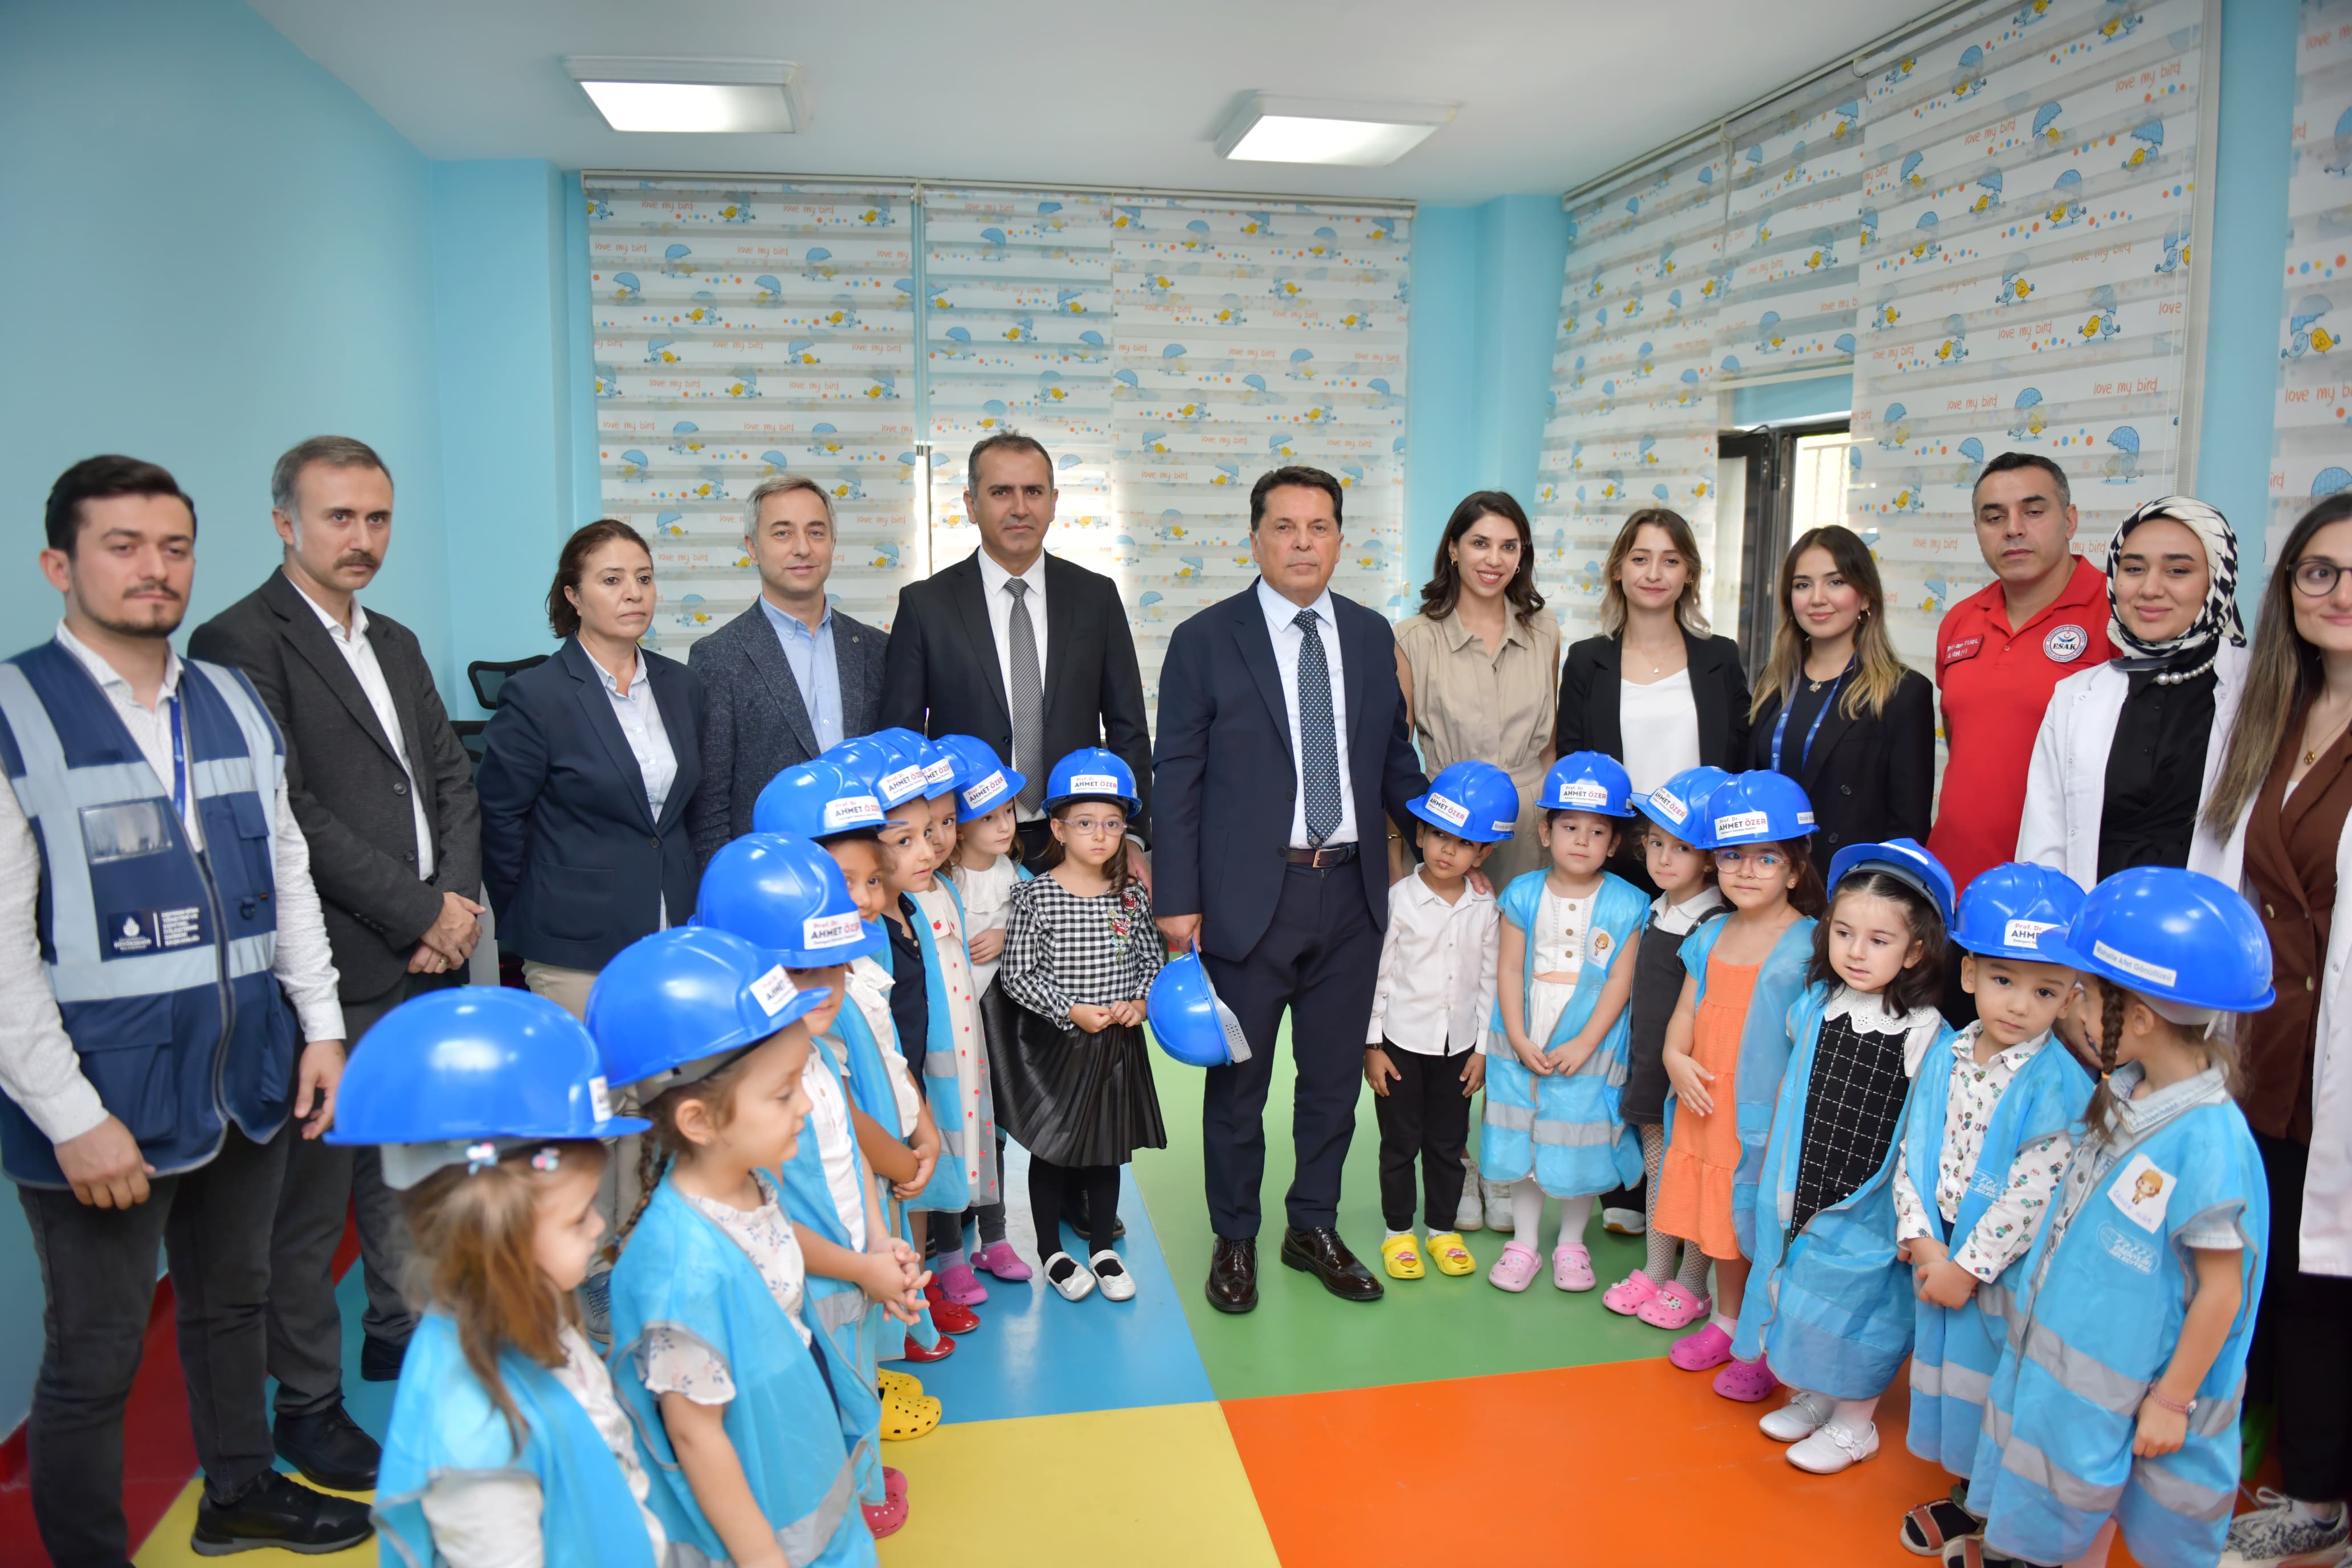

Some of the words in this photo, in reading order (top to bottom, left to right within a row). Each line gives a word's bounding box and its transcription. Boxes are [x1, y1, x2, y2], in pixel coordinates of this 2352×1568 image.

[2114, 76, 2135, 92] love
[2141, 72, 2155, 88] my
[2160, 58, 2180, 78] bird
[1964, 132, 1981, 145] love
[1984, 128, 1996, 142] my
[1999, 119, 2016, 133] bird
[1864, 173, 1873, 185] my
[1875, 164, 1888, 177] bird
[640, 199, 658, 209] love
[662, 202, 675, 212] my
[678, 200, 693, 211] bird
[783, 203, 799, 212] love
[803, 205, 816, 215] my
[819, 203, 835, 214] bird
[594, 241, 611, 251] love
[616, 244, 628, 255] my
[631, 244, 647, 252] bird
[757, 247, 770, 258] my
[773, 246, 789, 255] bird
[2071, 251, 2089, 263] love
[2094, 248, 2108, 263] my
[2112, 241, 2131, 255] bird
[897, 251, 909, 261] my
[1163, 305, 1174, 315] my
[1177, 304, 1191, 314] bird
[1820, 300, 1835, 312] love
[1838, 300, 1849, 309] my
[2158, 301, 2182, 315] love
[1272, 309, 1287, 317] love
[1291, 311, 1301, 320] my
[1304, 309, 1319, 319] bird
[1997, 328, 2015, 340] love
[2020, 326, 2032, 341] my
[2035, 320, 2052, 334] bird
[606, 337, 623, 347] bird
[712, 338, 728, 348] love
[733, 340, 745, 352] my
[748, 339, 764, 349] bird
[851, 340, 867, 350] love
[872, 343, 884, 354] my
[887, 343, 902, 353] bird
[1119, 344, 1130, 354] my
[1132, 343, 1148, 353] bird
[1228, 347, 1243, 356] love
[1247, 349, 1258, 359] my
[1261, 348, 1275, 358] bird
[1872, 350, 1885, 360] love
[1889, 349, 1897, 362] my
[1901, 345, 1914, 356] bird
[1372, 354, 1383, 364] my
[1385, 353, 1400, 362] bird
[649, 378, 665, 387] love
[669, 379, 682, 390] my
[685, 379, 701, 387] bird
[787, 381, 805, 389] love
[809, 382, 821, 392] my
[824, 382, 839, 391] bird
[2093, 382, 2112, 395] love
[2118, 383, 2132, 397] my
[2137, 376, 2158, 393] bird
[2284, 387, 2309, 403] love
[2317, 388, 2335, 406] my
[1946, 399, 1962, 410] love
[1966, 399, 1978, 412] my
[1981, 395, 1998, 407] bird
[602, 419, 620, 428] love
[623, 422, 636, 431] my
[639, 420, 655, 430] bird
[763, 423, 776, 432] my
[778, 422, 794, 431] bird
[881, 423, 897, 432] love
[901, 425, 912, 435] my
[1219, 436, 1230, 446] my
[1233, 436, 1248, 445] bird
[1344, 440, 1355, 449] my
[1357, 439, 1371, 448] bird
[1140, 469, 1157, 478] love
[1159, 472, 1170, 481] my
[1173, 471, 1188, 480] bird
[876, 517, 888, 526] my
[891, 516, 906, 525] bird
[1912, 538, 1926, 548] love
[1930, 540, 1940, 553] my
[1943, 538, 1958, 550] bird
[2072, 542, 2084, 554] my
[2089, 538, 2106, 556] bird
[658, 552, 674, 561] love
[677, 554, 690, 564] my
[693, 553, 709, 561] bird
[1197, 597, 1213, 606] love
[889, 776, 911, 791] AHMET
[970, 786, 990, 802] AHMET
[989, 777, 1003, 788] ÖZER
[1100, 780, 1117, 789] ÖZER
[1589, 790, 1606, 799] ÖZER
[835, 806, 862, 816] AHMET
[1430, 798, 1448, 810] AHMET
[1448, 807, 1465, 820] ÖZER
[1655, 792, 1671, 805] AHMET
[1669, 802, 1685, 818] ÖZER
[1719, 821, 1742, 831] AHMET
[811, 926, 842, 939] AHMET
[2118, 957, 2132, 969] Afet
